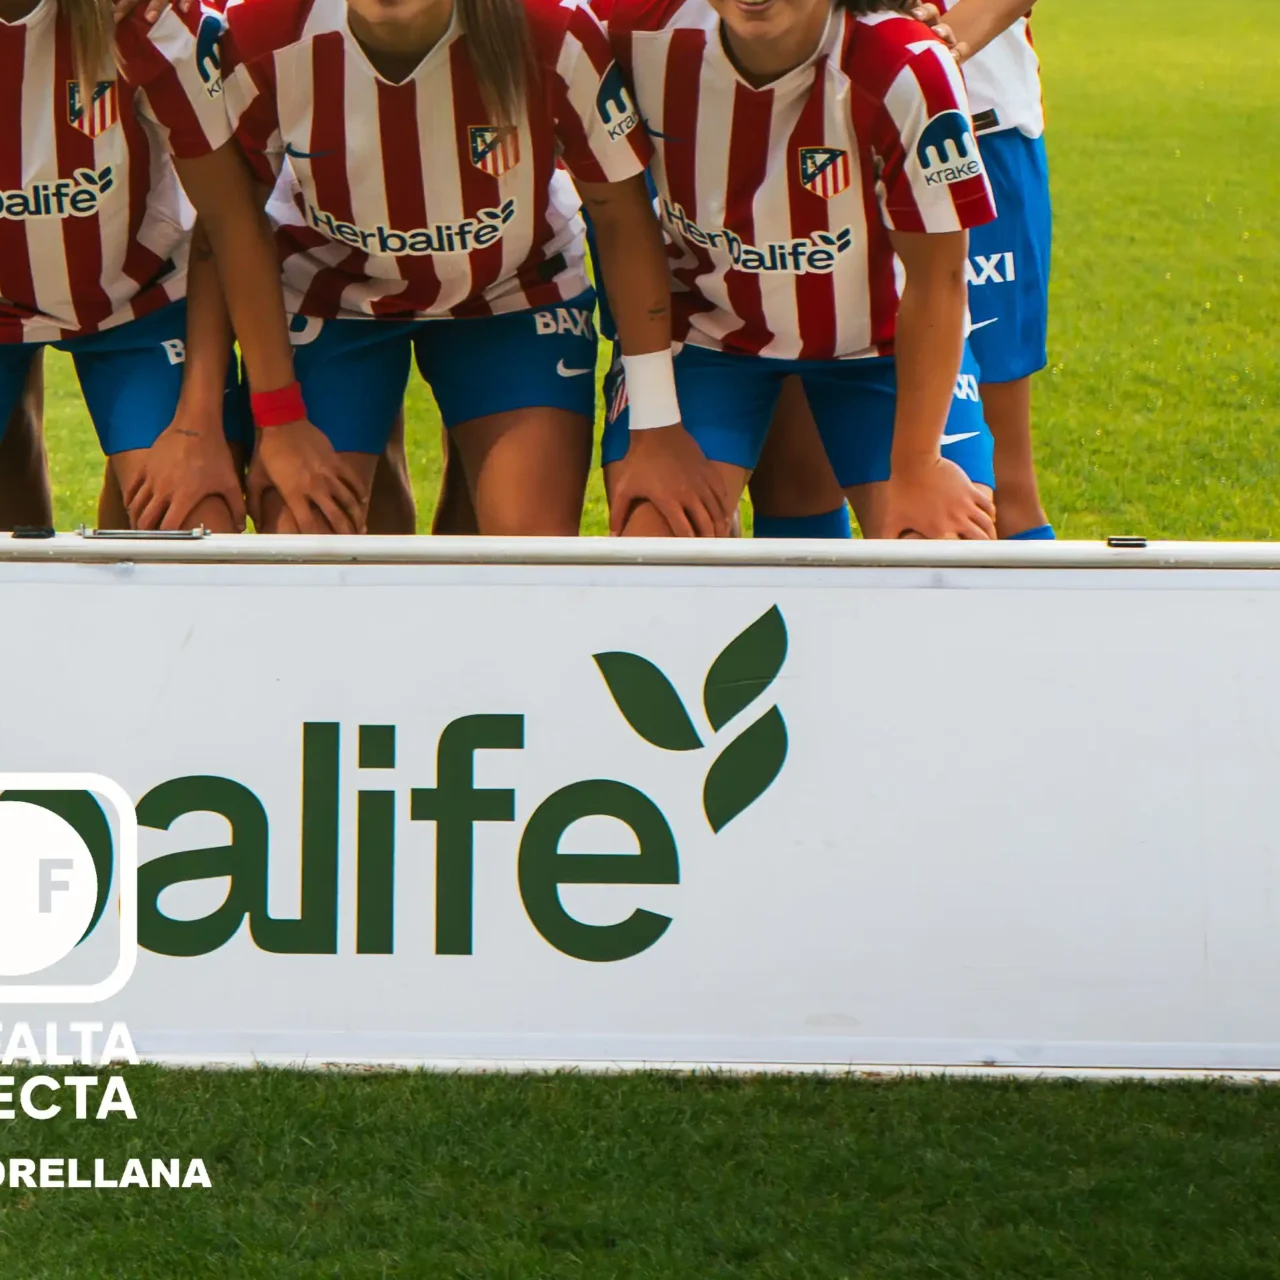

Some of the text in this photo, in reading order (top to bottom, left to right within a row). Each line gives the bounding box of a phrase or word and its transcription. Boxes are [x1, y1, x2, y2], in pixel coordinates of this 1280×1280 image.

[607, 112, 637, 140] kra
[309, 204, 500, 252] Herbalife
[664, 199, 835, 270] Herbalife
